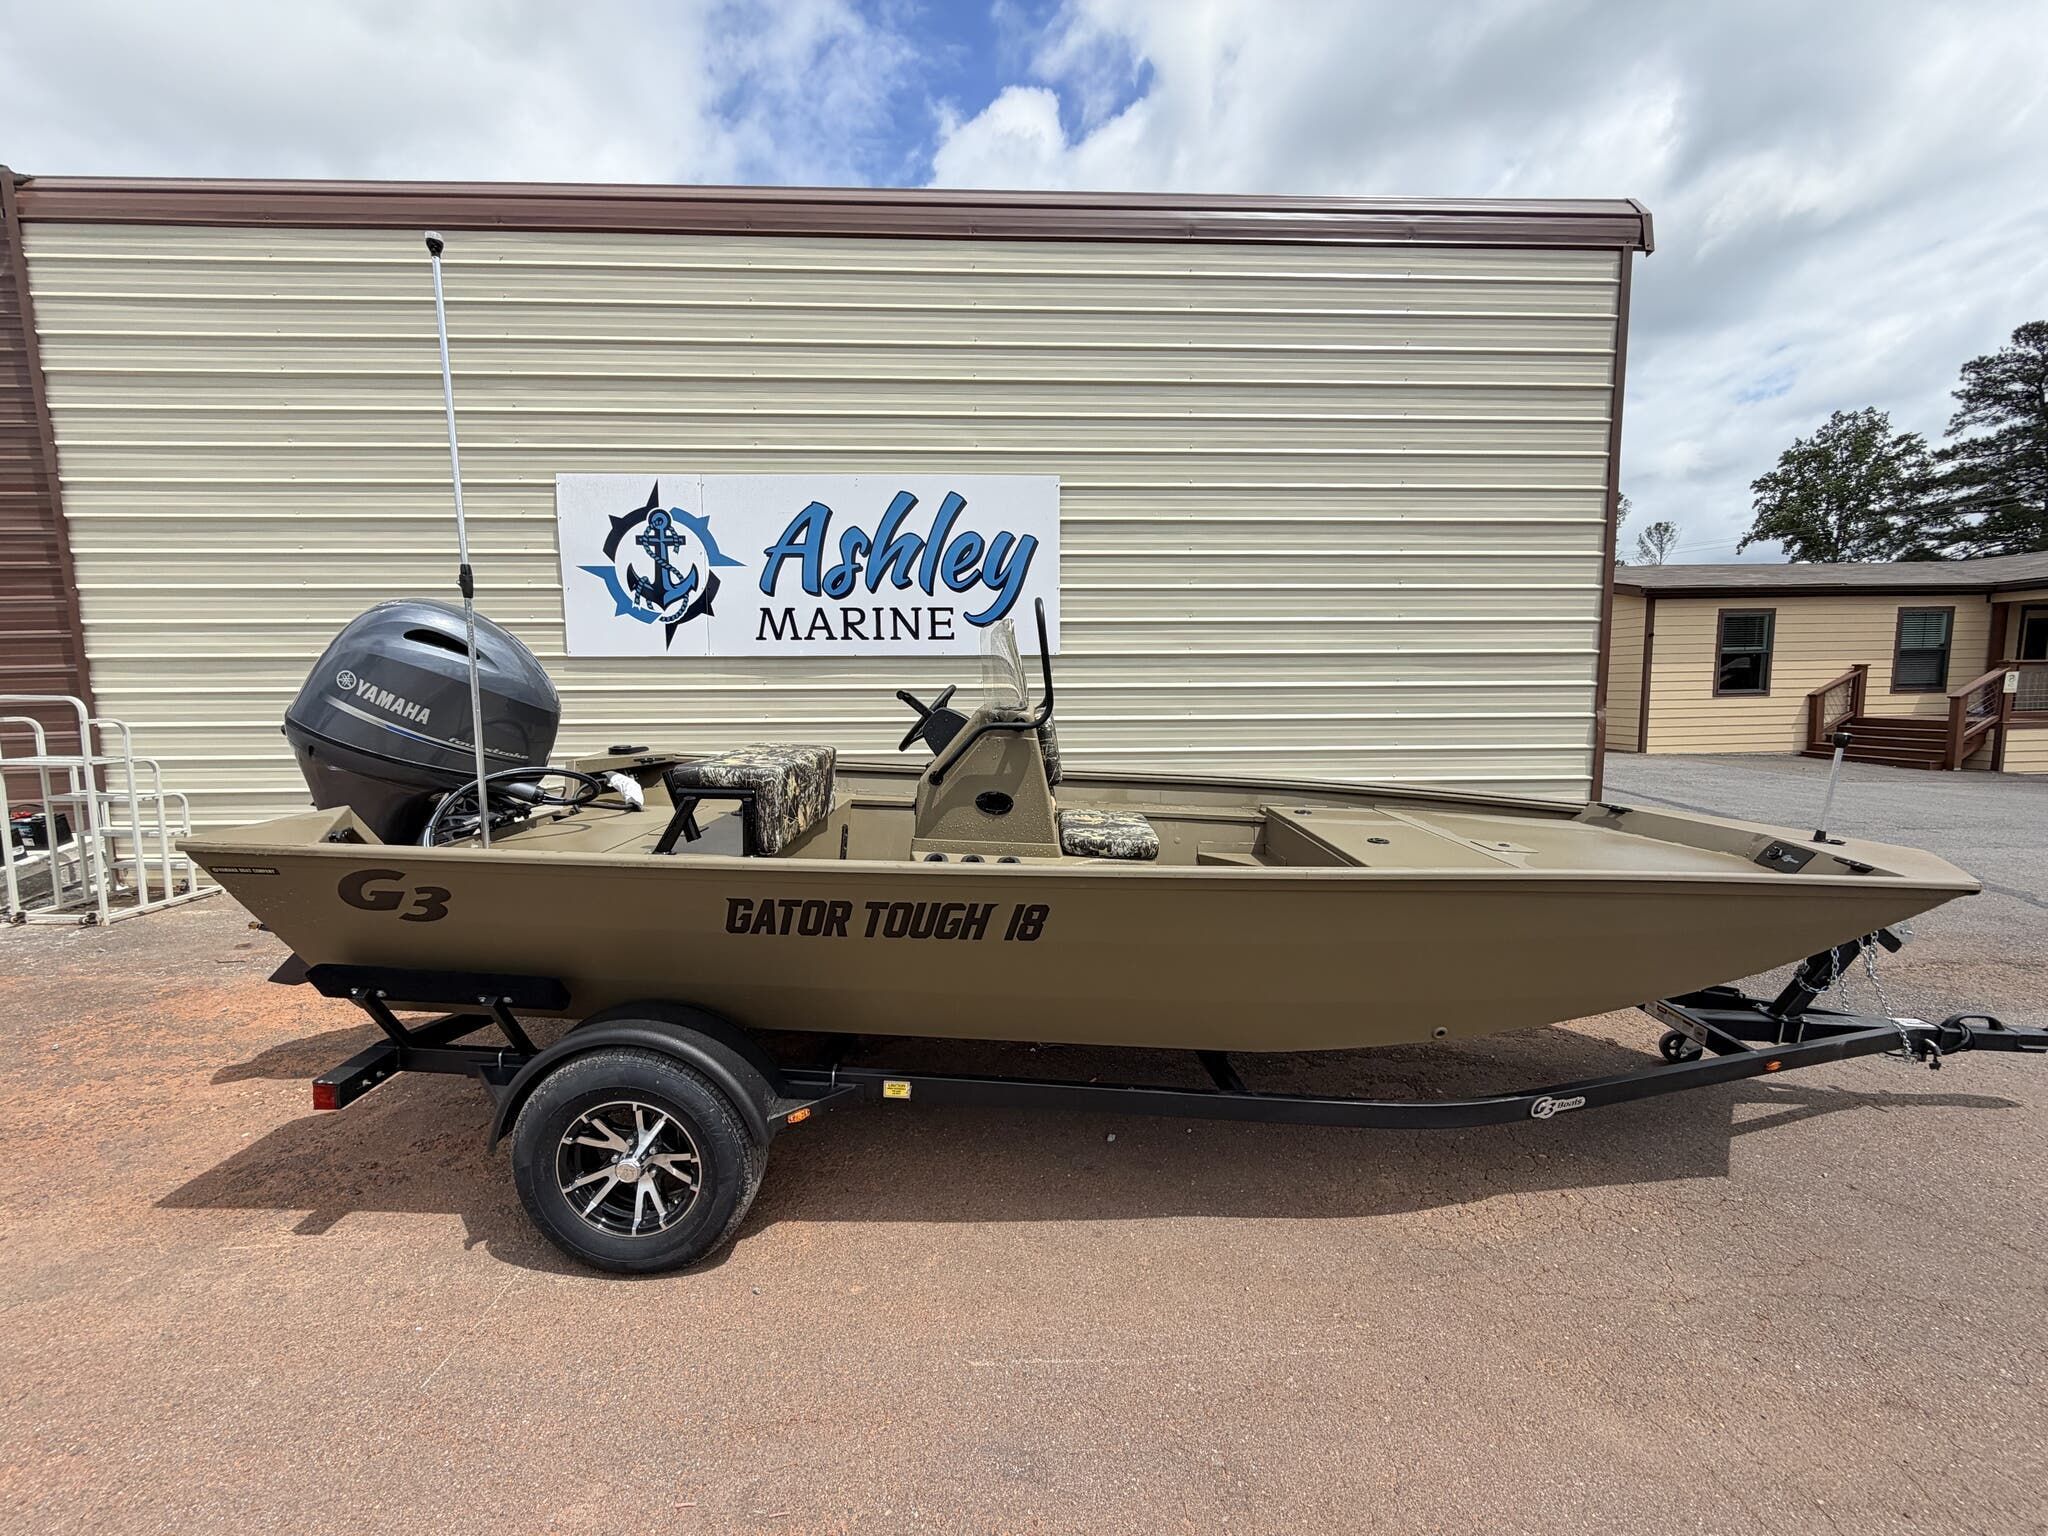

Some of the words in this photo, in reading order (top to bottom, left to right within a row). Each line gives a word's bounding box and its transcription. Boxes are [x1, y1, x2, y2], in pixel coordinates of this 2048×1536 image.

[760, 491, 1039, 627] Ashley
[756, 607, 956, 641] MARINE
[355, 679, 431, 725] YAMAHA
[337, 868, 452, 923] G3
[725, 898, 853, 938] GATOR
[863, 901, 999, 941] TOUGH
[1004, 903, 1050, 942] 18
